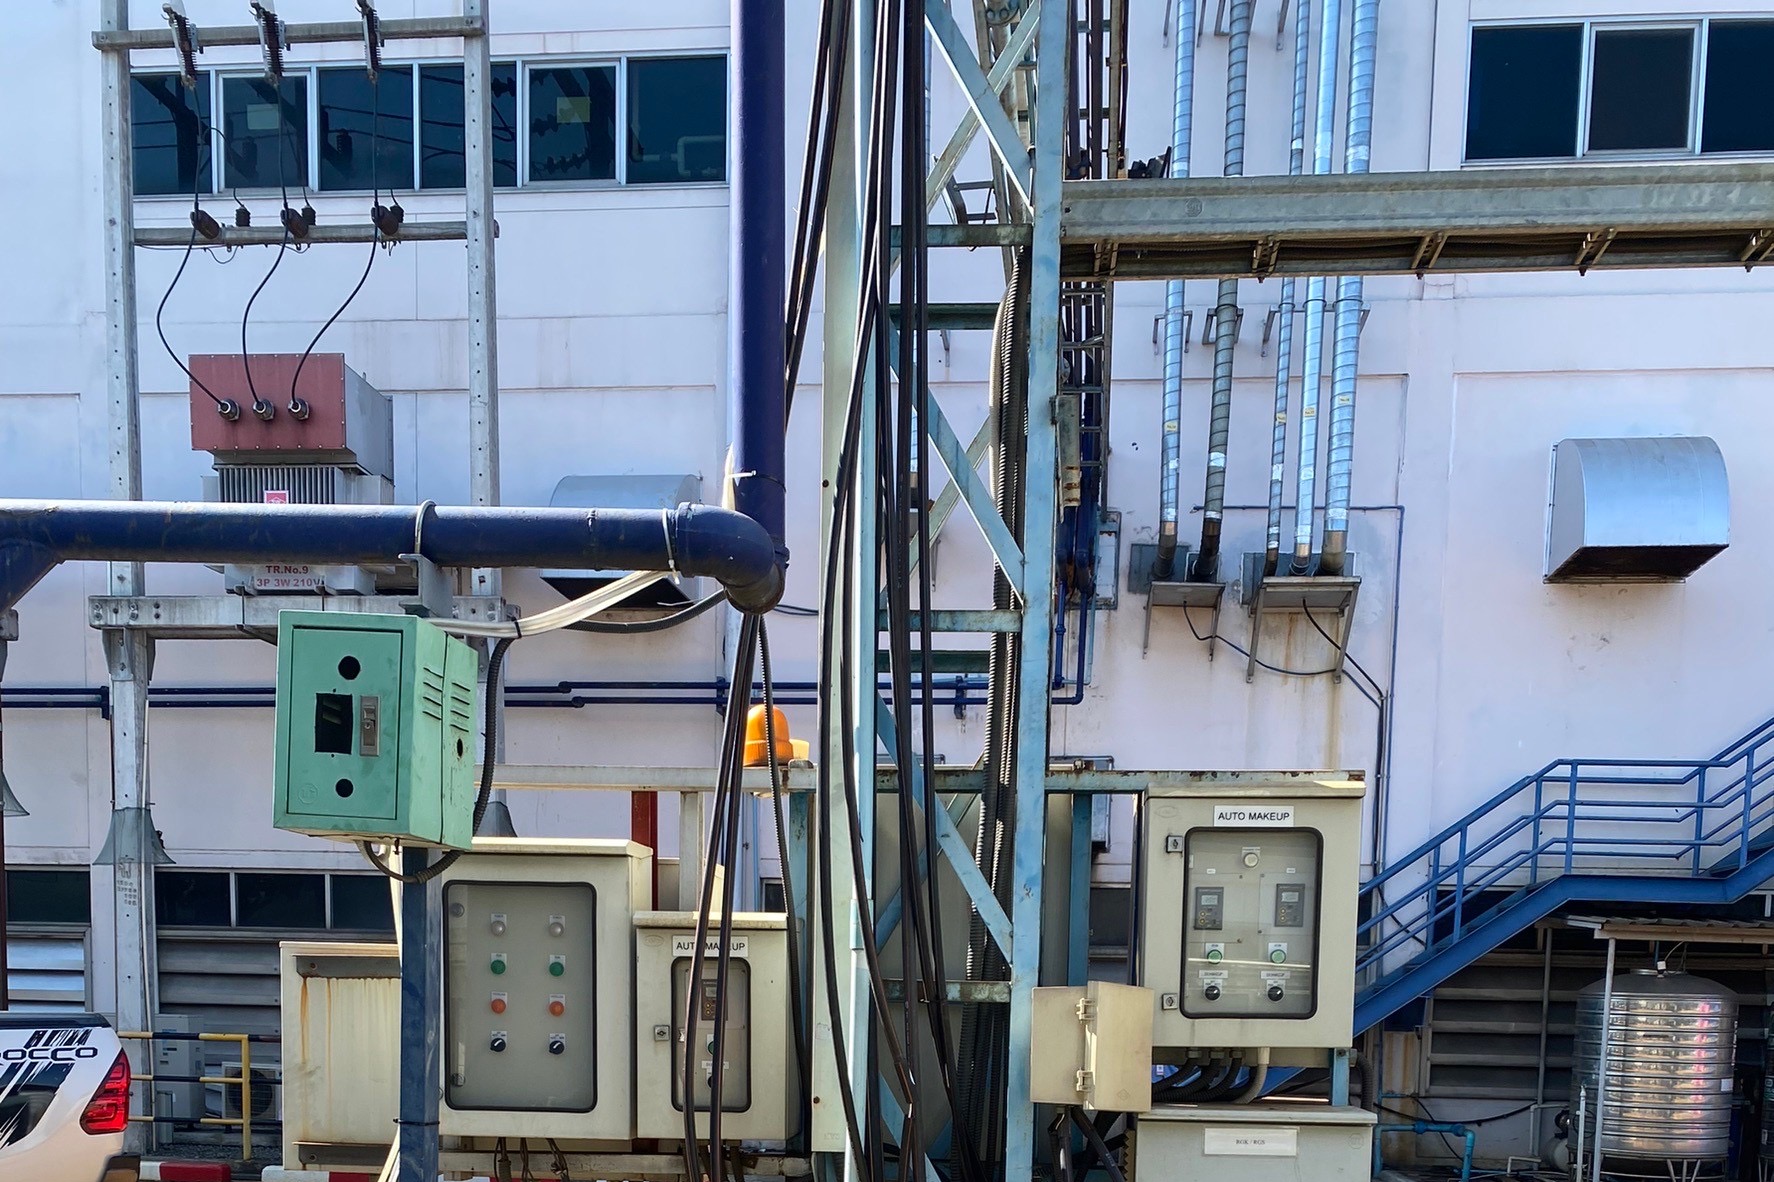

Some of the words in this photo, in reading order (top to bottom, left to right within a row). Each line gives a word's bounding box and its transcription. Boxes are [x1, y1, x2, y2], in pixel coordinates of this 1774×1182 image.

[266, 565, 309, 574] TR.No.9
[256, 578, 270, 587] 3P
[274, 578, 290, 587] 3W
[293, 578, 320, 587] 210V
[1217, 811, 1246, 821] AUTO
[1248, 811, 1290, 821] MAKEUP
[676, 941, 698, 950] AUT
[705, 941, 746, 951] MAUP
[0, 1046, 98, 1062] OCCO
